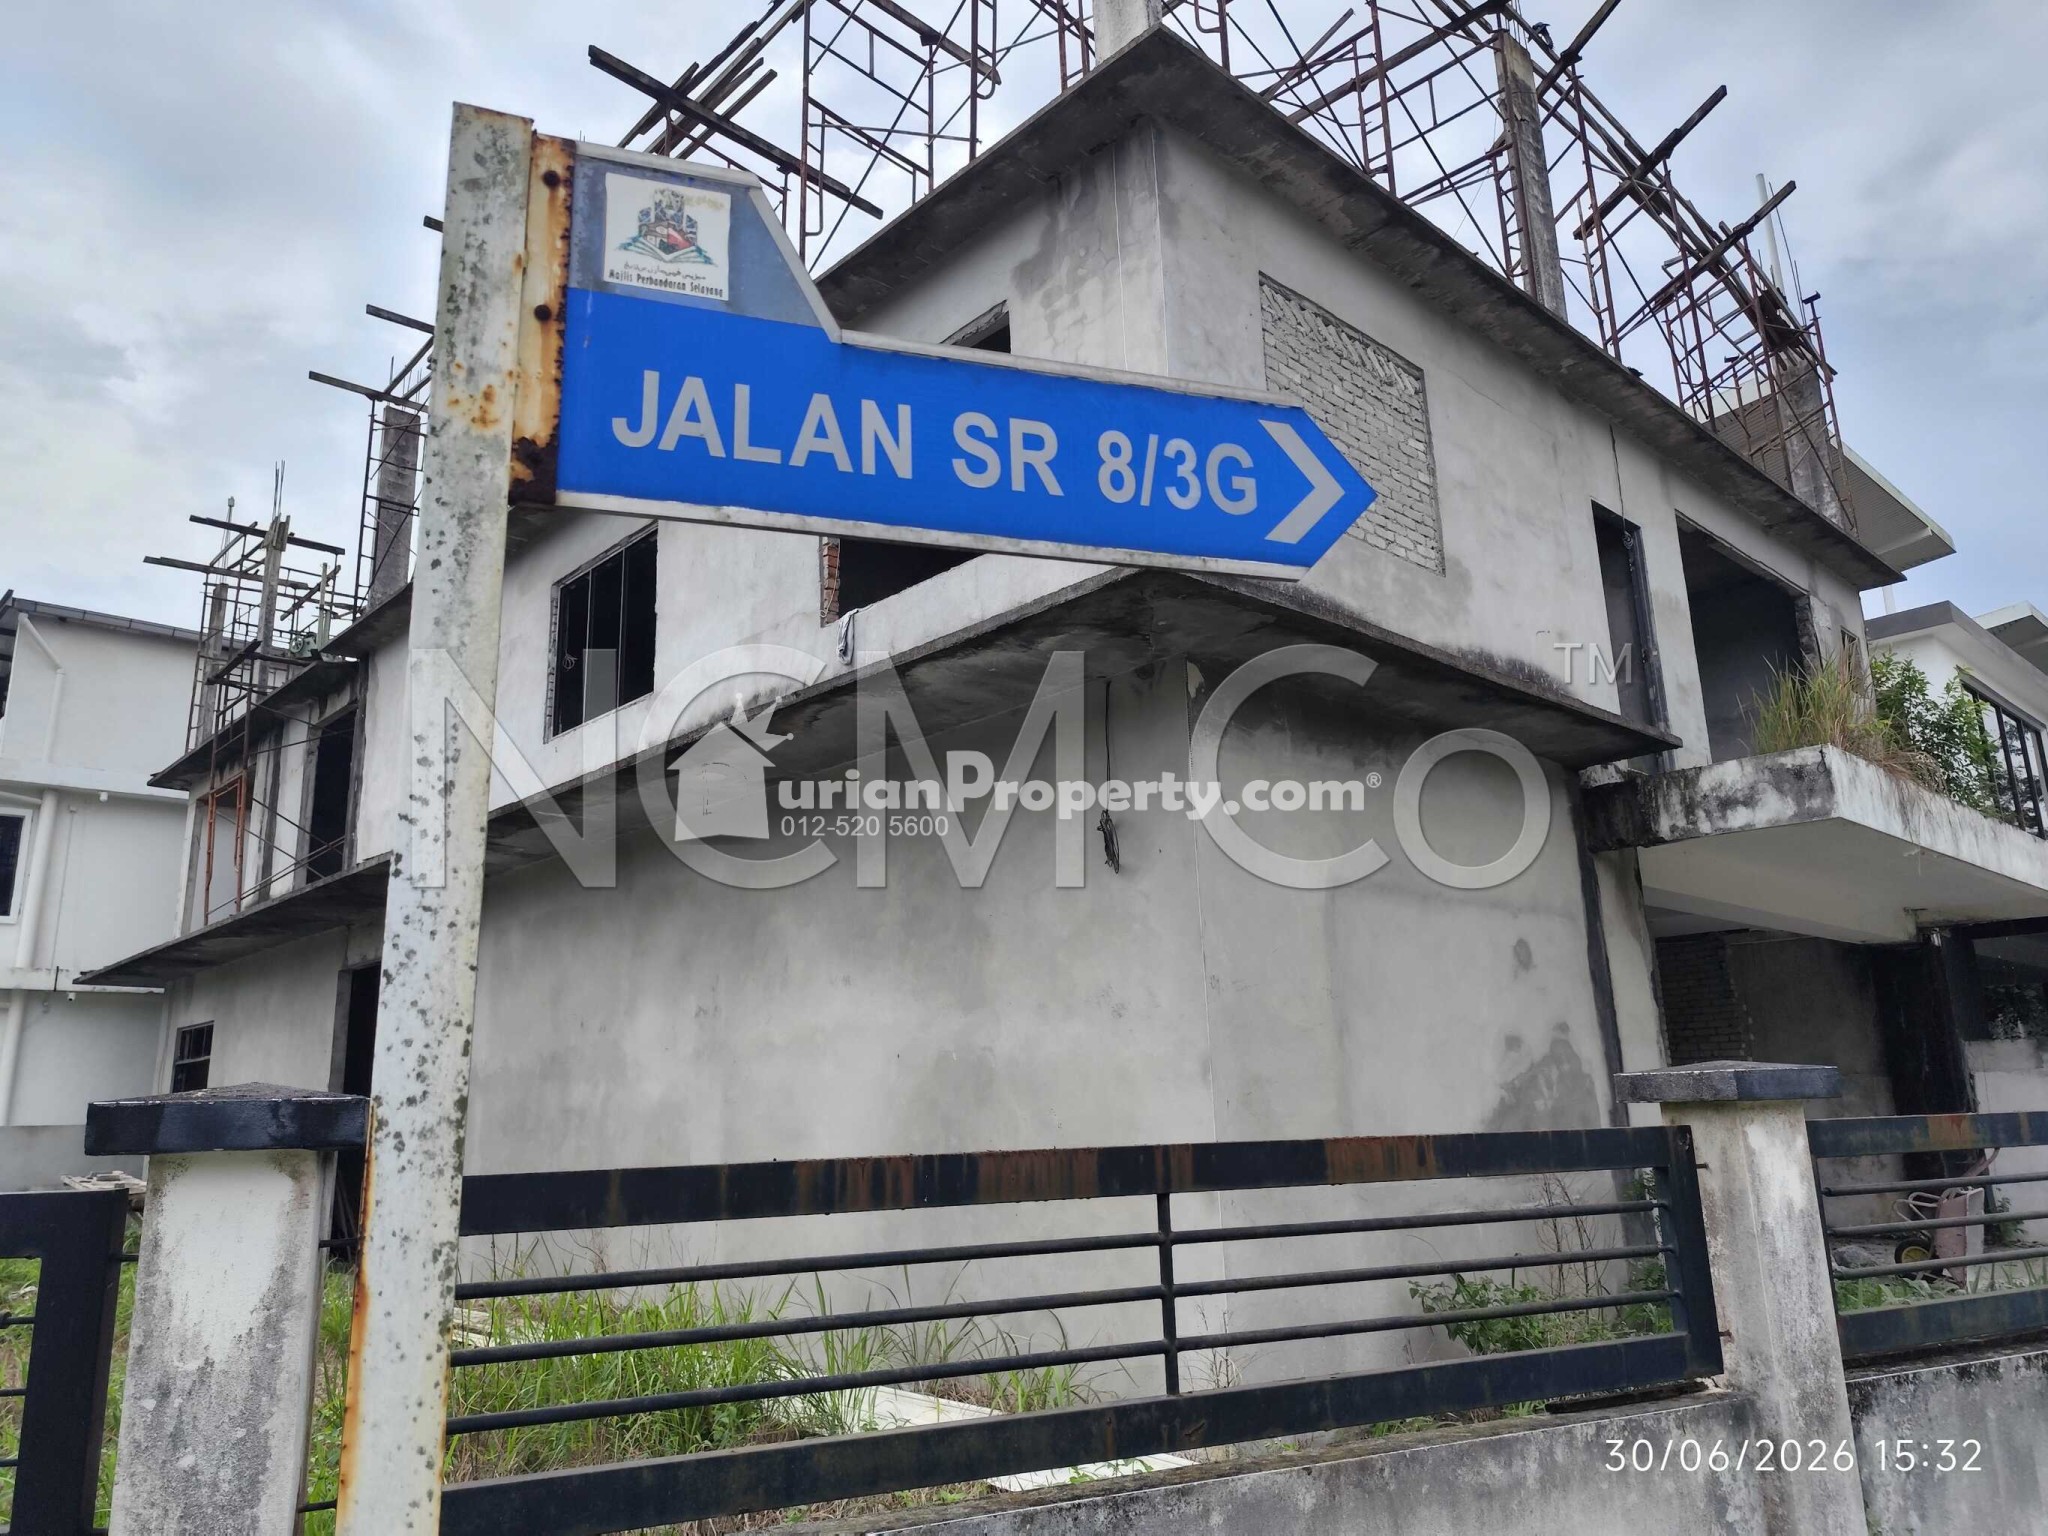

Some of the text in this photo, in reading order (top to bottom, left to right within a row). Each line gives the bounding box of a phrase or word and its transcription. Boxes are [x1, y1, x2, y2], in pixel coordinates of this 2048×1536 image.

[636, 273, 686, 291] Perbandaran
[612, 370, 1258, 515] JALAN SR 8/3G
